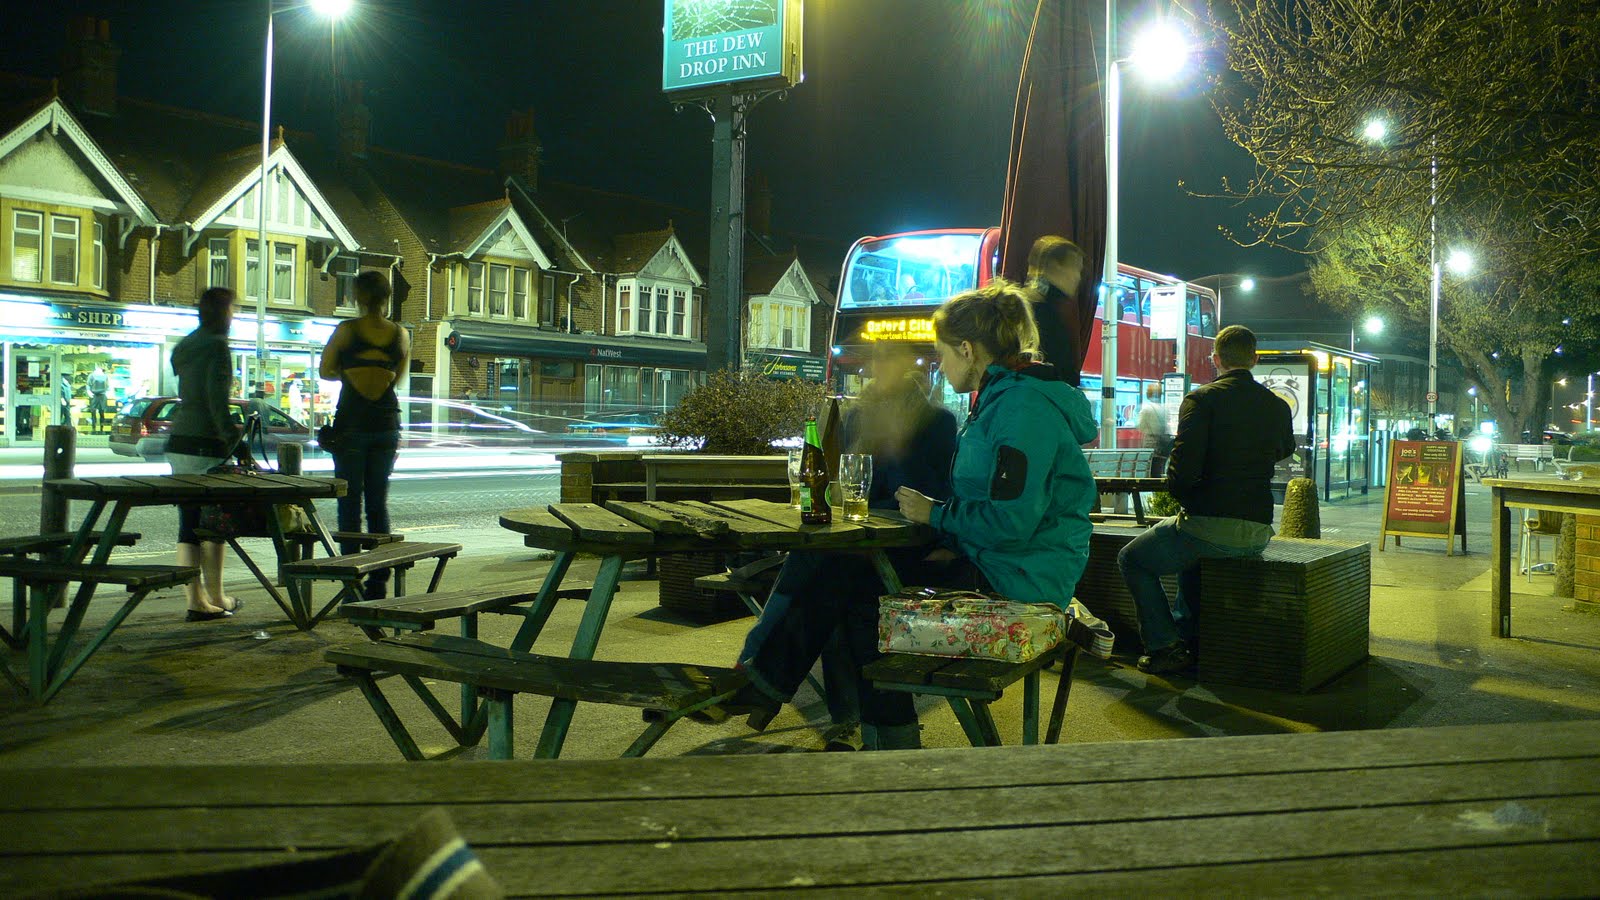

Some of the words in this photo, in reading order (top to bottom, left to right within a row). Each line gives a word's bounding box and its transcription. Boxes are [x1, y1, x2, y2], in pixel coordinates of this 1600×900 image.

[684, 39, 717, 57] THE
[723, 32, 763, 52] DEW
[680, 58, 727, 78] DROP
[733, 52, 766, 70] INN
[78, 311, 124, 326] SHEP
[867, 319, 906, 332] Oxford
[597, 349, 622, 358] NatWest
